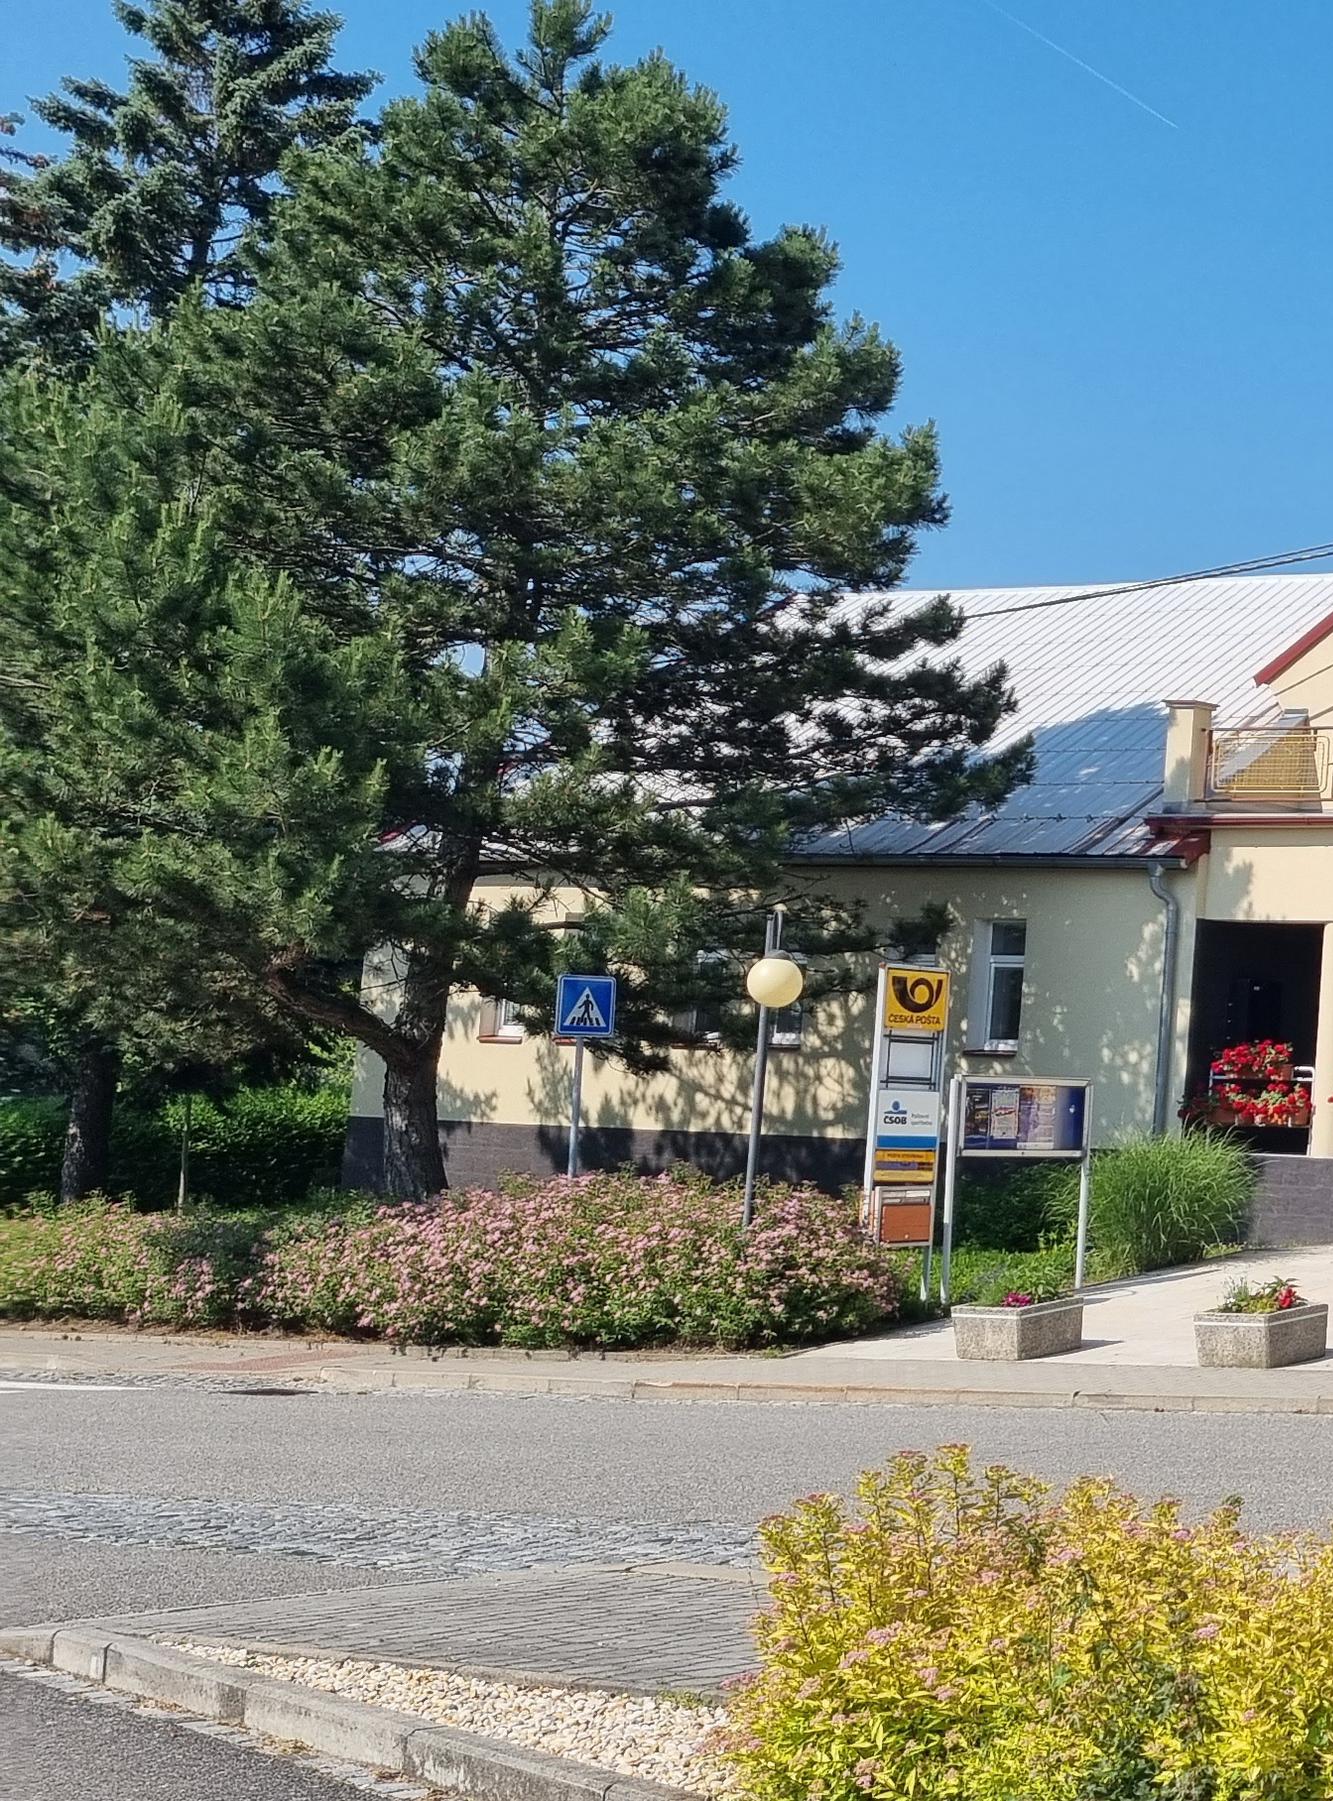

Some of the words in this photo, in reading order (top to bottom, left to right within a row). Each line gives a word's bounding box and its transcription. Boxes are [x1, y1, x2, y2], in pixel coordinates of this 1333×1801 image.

[888, 1013, 914, 1024] ČESKÁ
[915, 1014, 942, 1026] POŠTA
[883, 1115, 907, 1125] ČSOB
